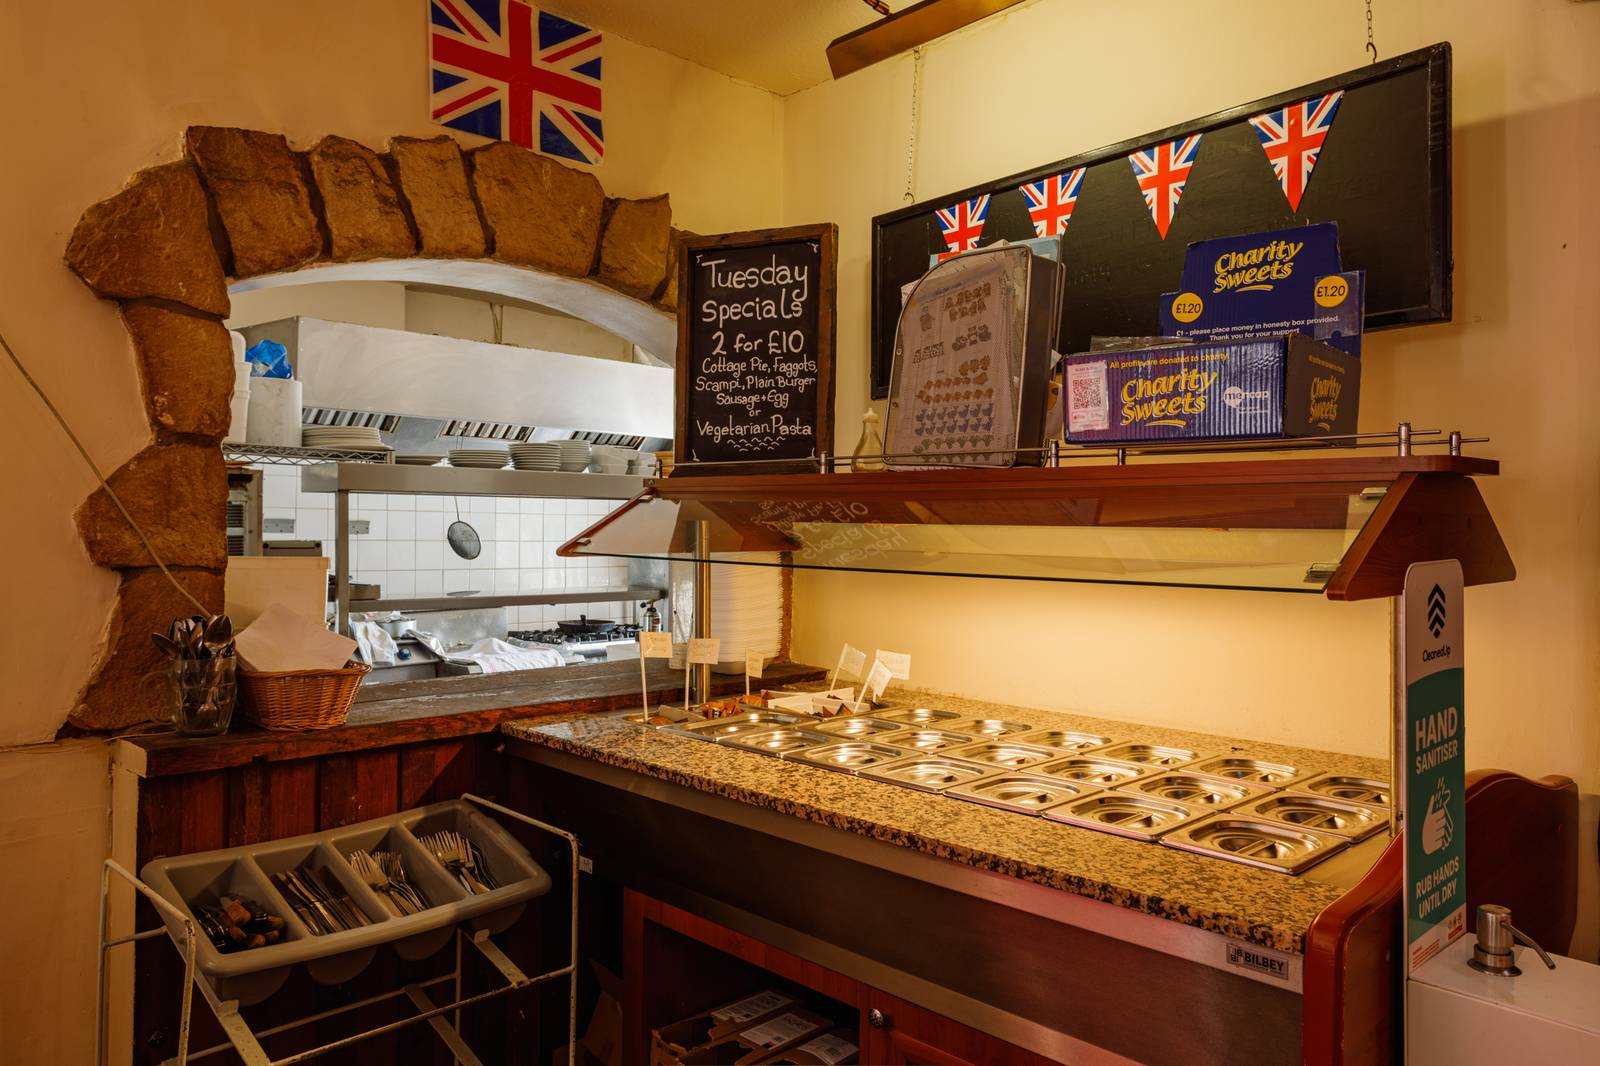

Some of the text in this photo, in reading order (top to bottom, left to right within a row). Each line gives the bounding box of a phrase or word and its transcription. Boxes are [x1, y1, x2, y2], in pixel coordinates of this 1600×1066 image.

[1215, 240, 1304, 274] Charity
[701, 254, 808, 301] Tuesday
[1213, 260, 1294, 293] Sweets
[1316, 285, 1346, 298] £1.20
[702, 288, 802, 328] Specials
[1175, 303, 1201, 314] £1.20
[1189, 328, 1211, 336] please
[1212, 326, 1230, 334] place
[1231, 325, 1255, 333] money
[1263, 321, 1290, 329] honesty
[1306, 315, 1339, 325] provided.
[1255, 330, 1271, 338] your
[712, 330, 804, 355] 2 for £10
[702, 353, 818, 378] Cottage Pie, Faggots,
[1110, 361, 1119, 369] All
[1159, 355, 1189, 364] donated
[696, 375, 816, 393] Scampi, Plain Burger
[1121, 367, 1217, 404] Charity
[749, 409, 761, 417] or
[1120, 392, 1209, 426] Sweets
[696, 414, 812, 443] Vegetarian Pasta
[1423, 645, 1451, 662] CleanedUp
[1415, 706, 1458, 752] HAND
[1416, 739, 1458, 775] SANITISER
[1416, 856, 1460, 898] RUB HANDS
[1419, 878, 1457, 919] UNTIL DRY
[1244, 952, 1284, 971] BILBEY
